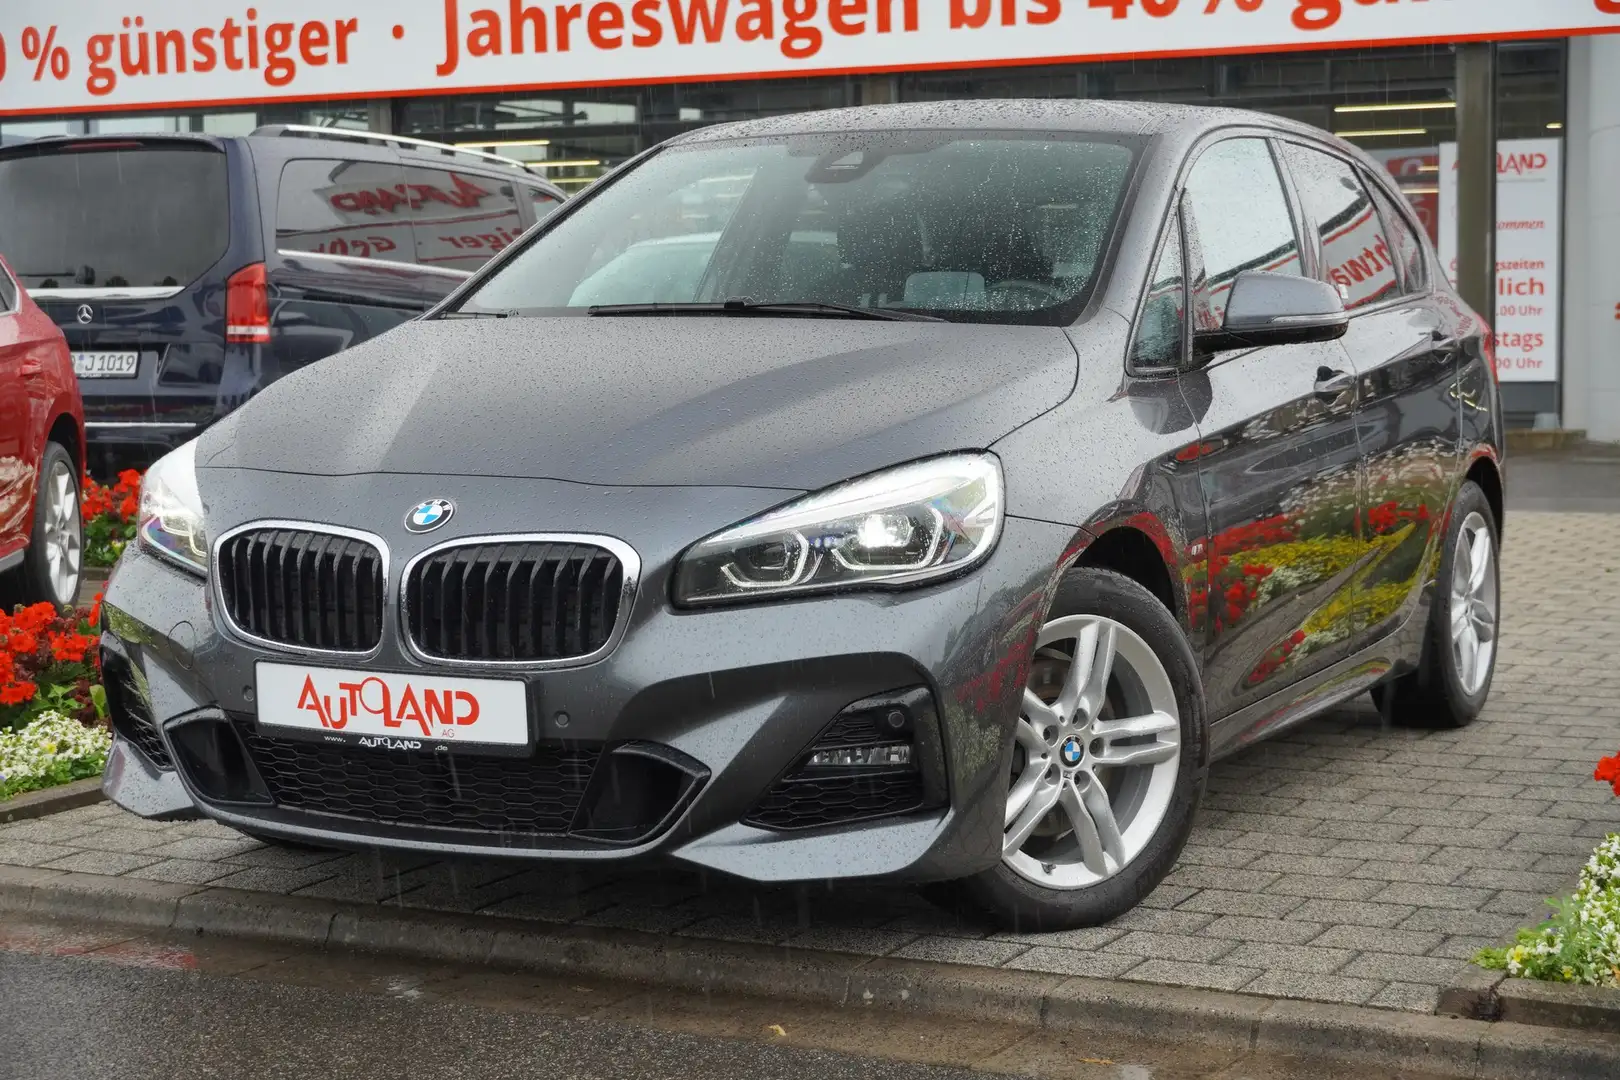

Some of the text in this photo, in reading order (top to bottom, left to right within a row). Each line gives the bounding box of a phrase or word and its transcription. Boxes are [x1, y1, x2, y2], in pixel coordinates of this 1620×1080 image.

[21, 25, 69, 81] %
[86, 8, 357, 95] günstiger
[436, 0, 918, 77] Jahreswagen
[1519, 304, 1543, 317] Uhr
[1516, 357, 1543, 369] Uhr
[441, 728, 456, 739] AG
